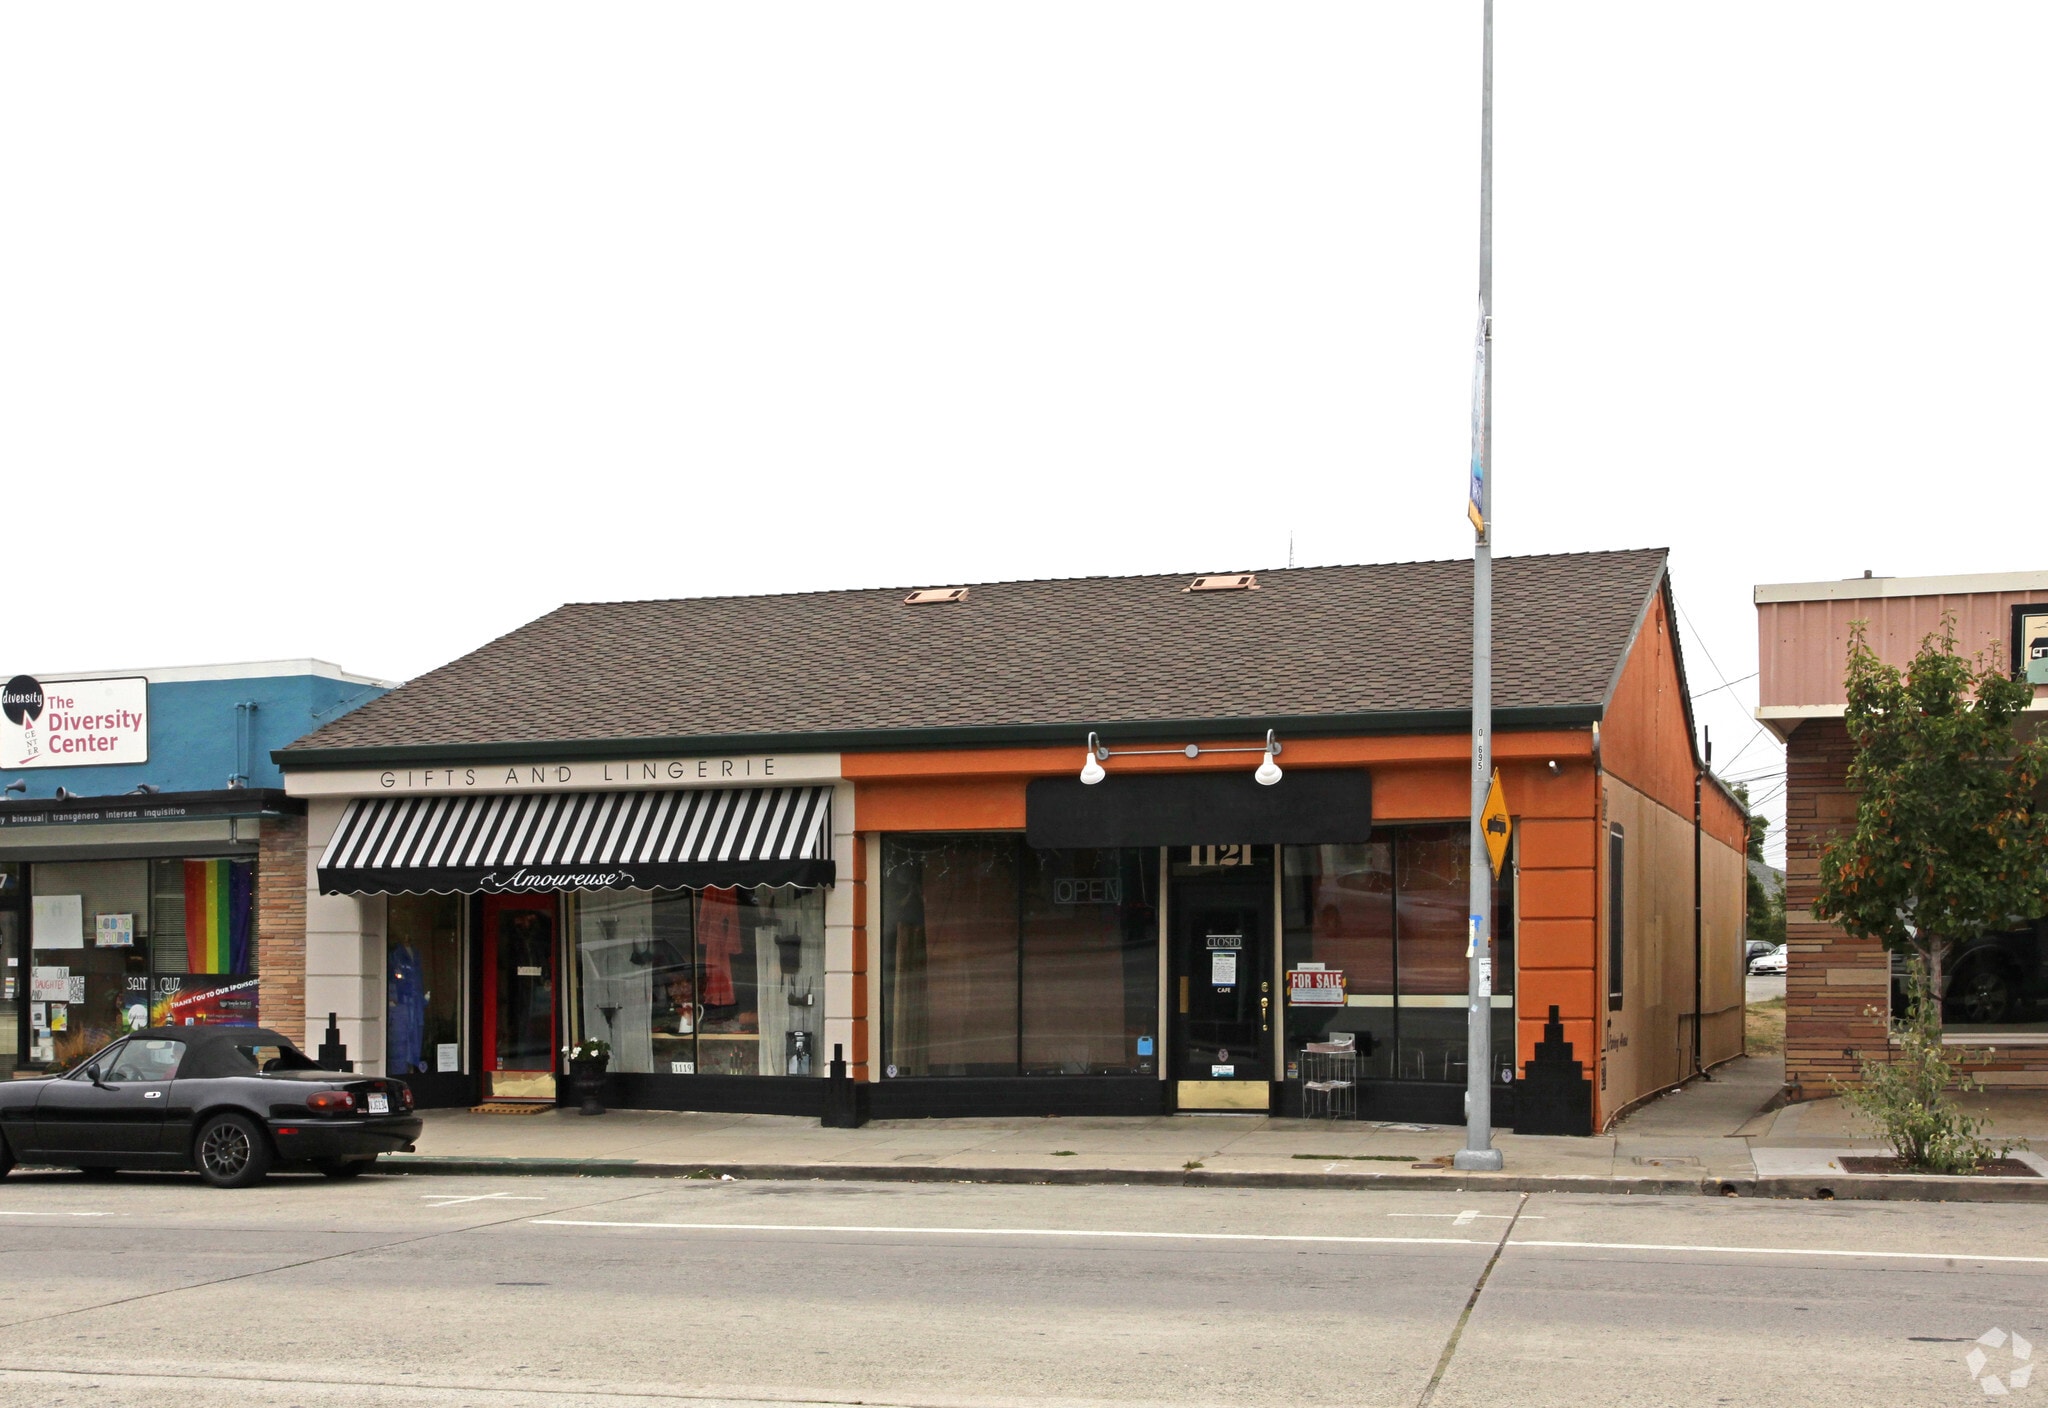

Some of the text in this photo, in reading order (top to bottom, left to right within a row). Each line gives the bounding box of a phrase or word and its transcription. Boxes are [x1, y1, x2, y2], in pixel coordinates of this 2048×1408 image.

[3, 690, 43, 707] diversity
[47, 696, 74, 709] The
[49, 709, 143, 732] Diversity
[49, 734, 119, 753] Center
[380, 758, 774, 788] GIFTS AND LINGERIE
[12, 814, 44, 823] bisexual
[106, 809, 138, 819] intersex
[144, 807, 186, 818] inquisitivo
[1187, 843, 1254, 867] 1121
[495, 868, 619, 887] Amoureuse
[1057, 880, 1120, 902] OPEN
[98, 931, 130, 944] PRIDE
[1207, 937, 1241, 947] CLOSED
[1292, 973, 1342, 988] FOR SALE
[674, 1063, 692, 1073] 1119
